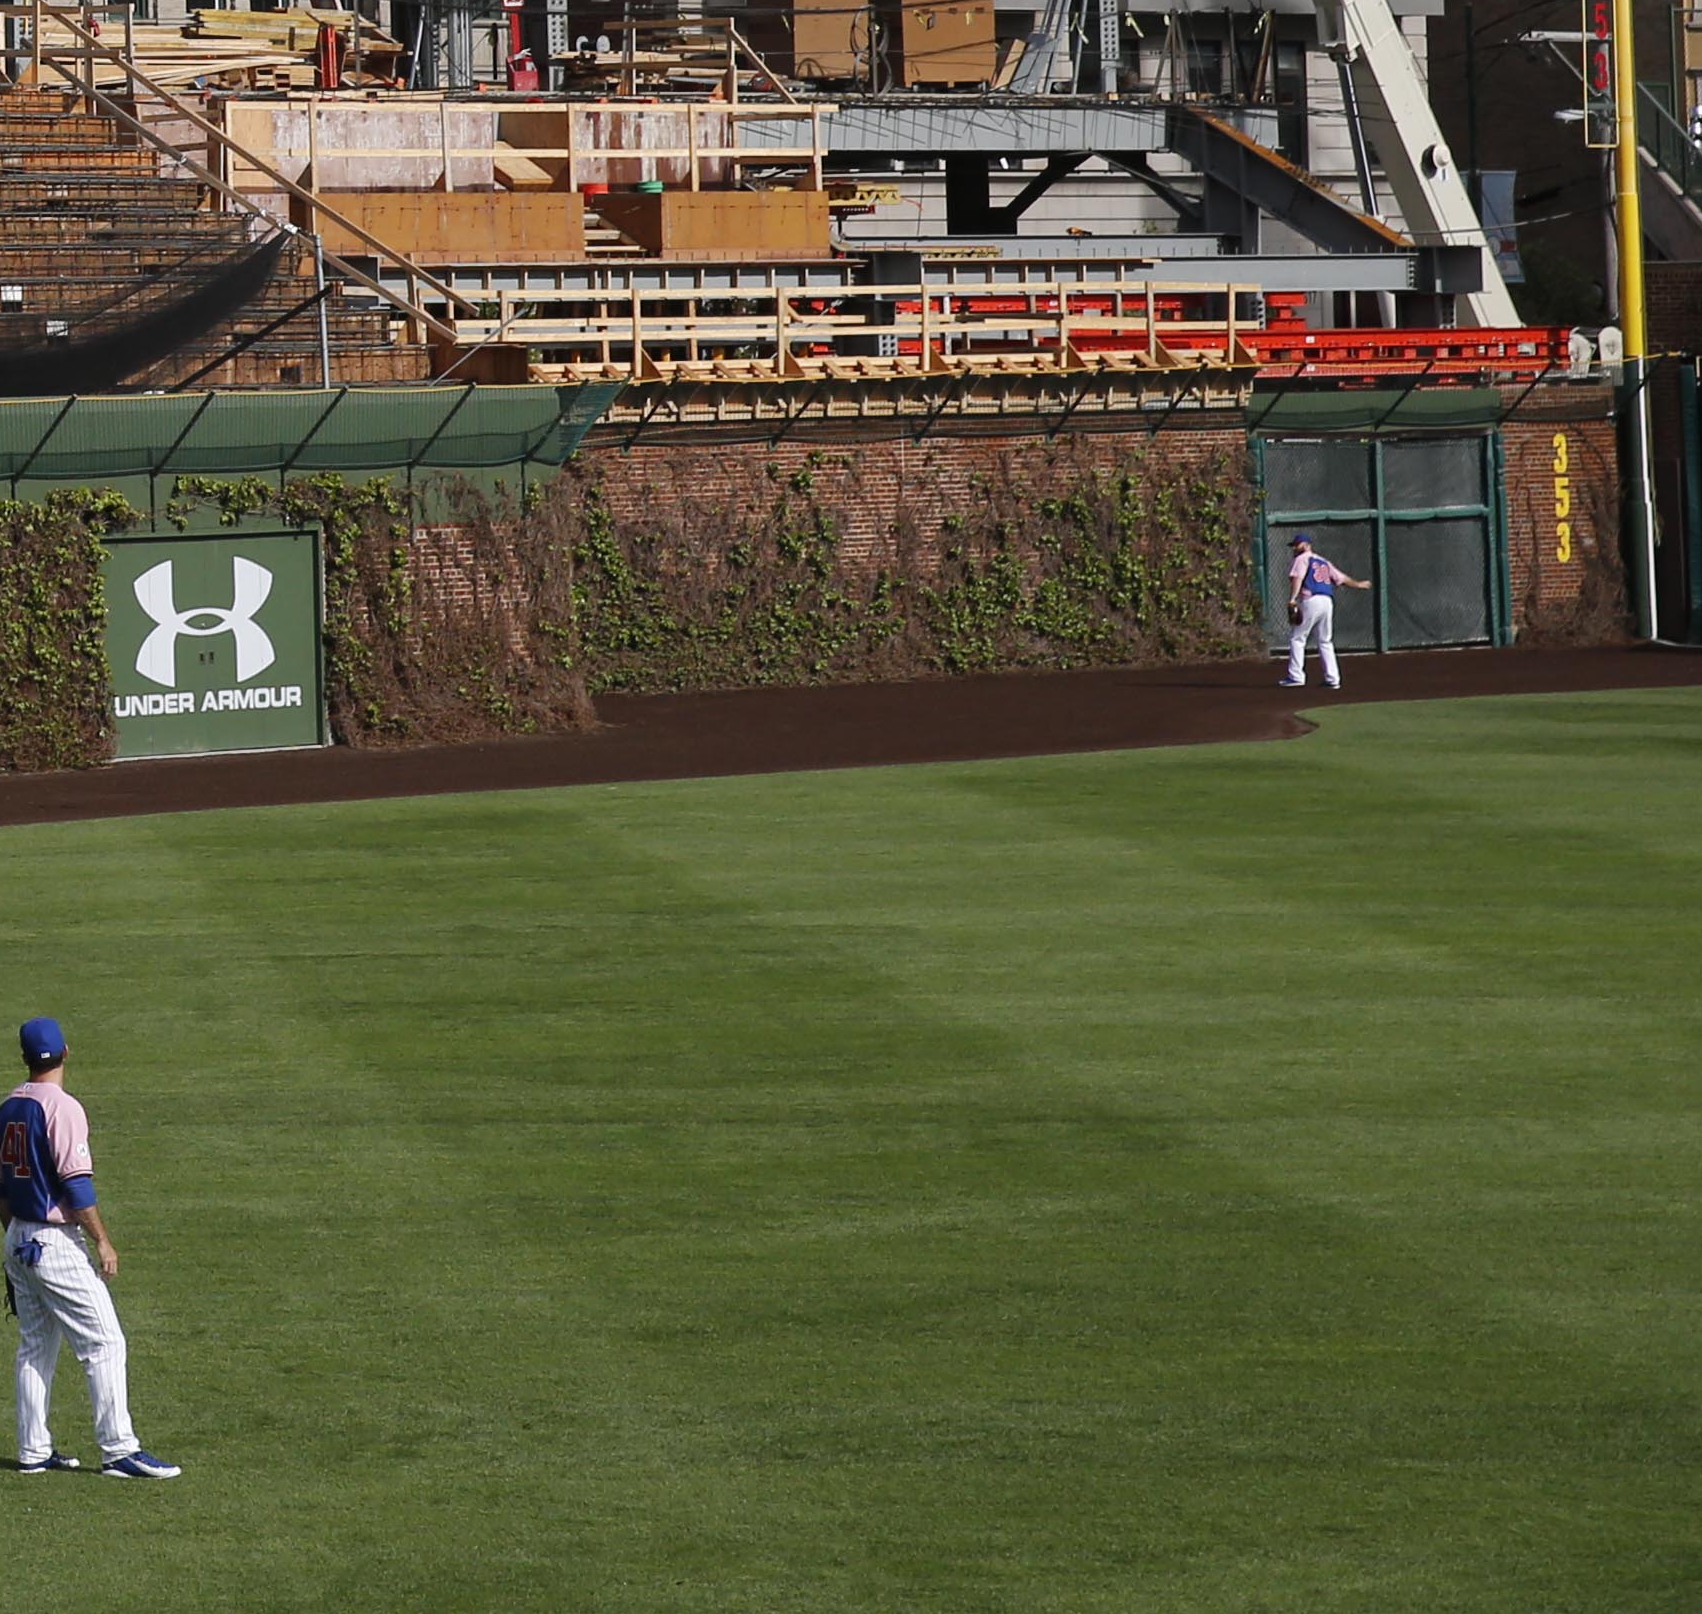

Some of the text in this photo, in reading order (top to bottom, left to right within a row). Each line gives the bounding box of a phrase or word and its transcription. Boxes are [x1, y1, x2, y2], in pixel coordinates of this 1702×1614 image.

[1552, 433, 1571, 563] 353
[114, 686, 302, 719] UNDER ARMOUR
[0, 1121, 31, 1178] 41
